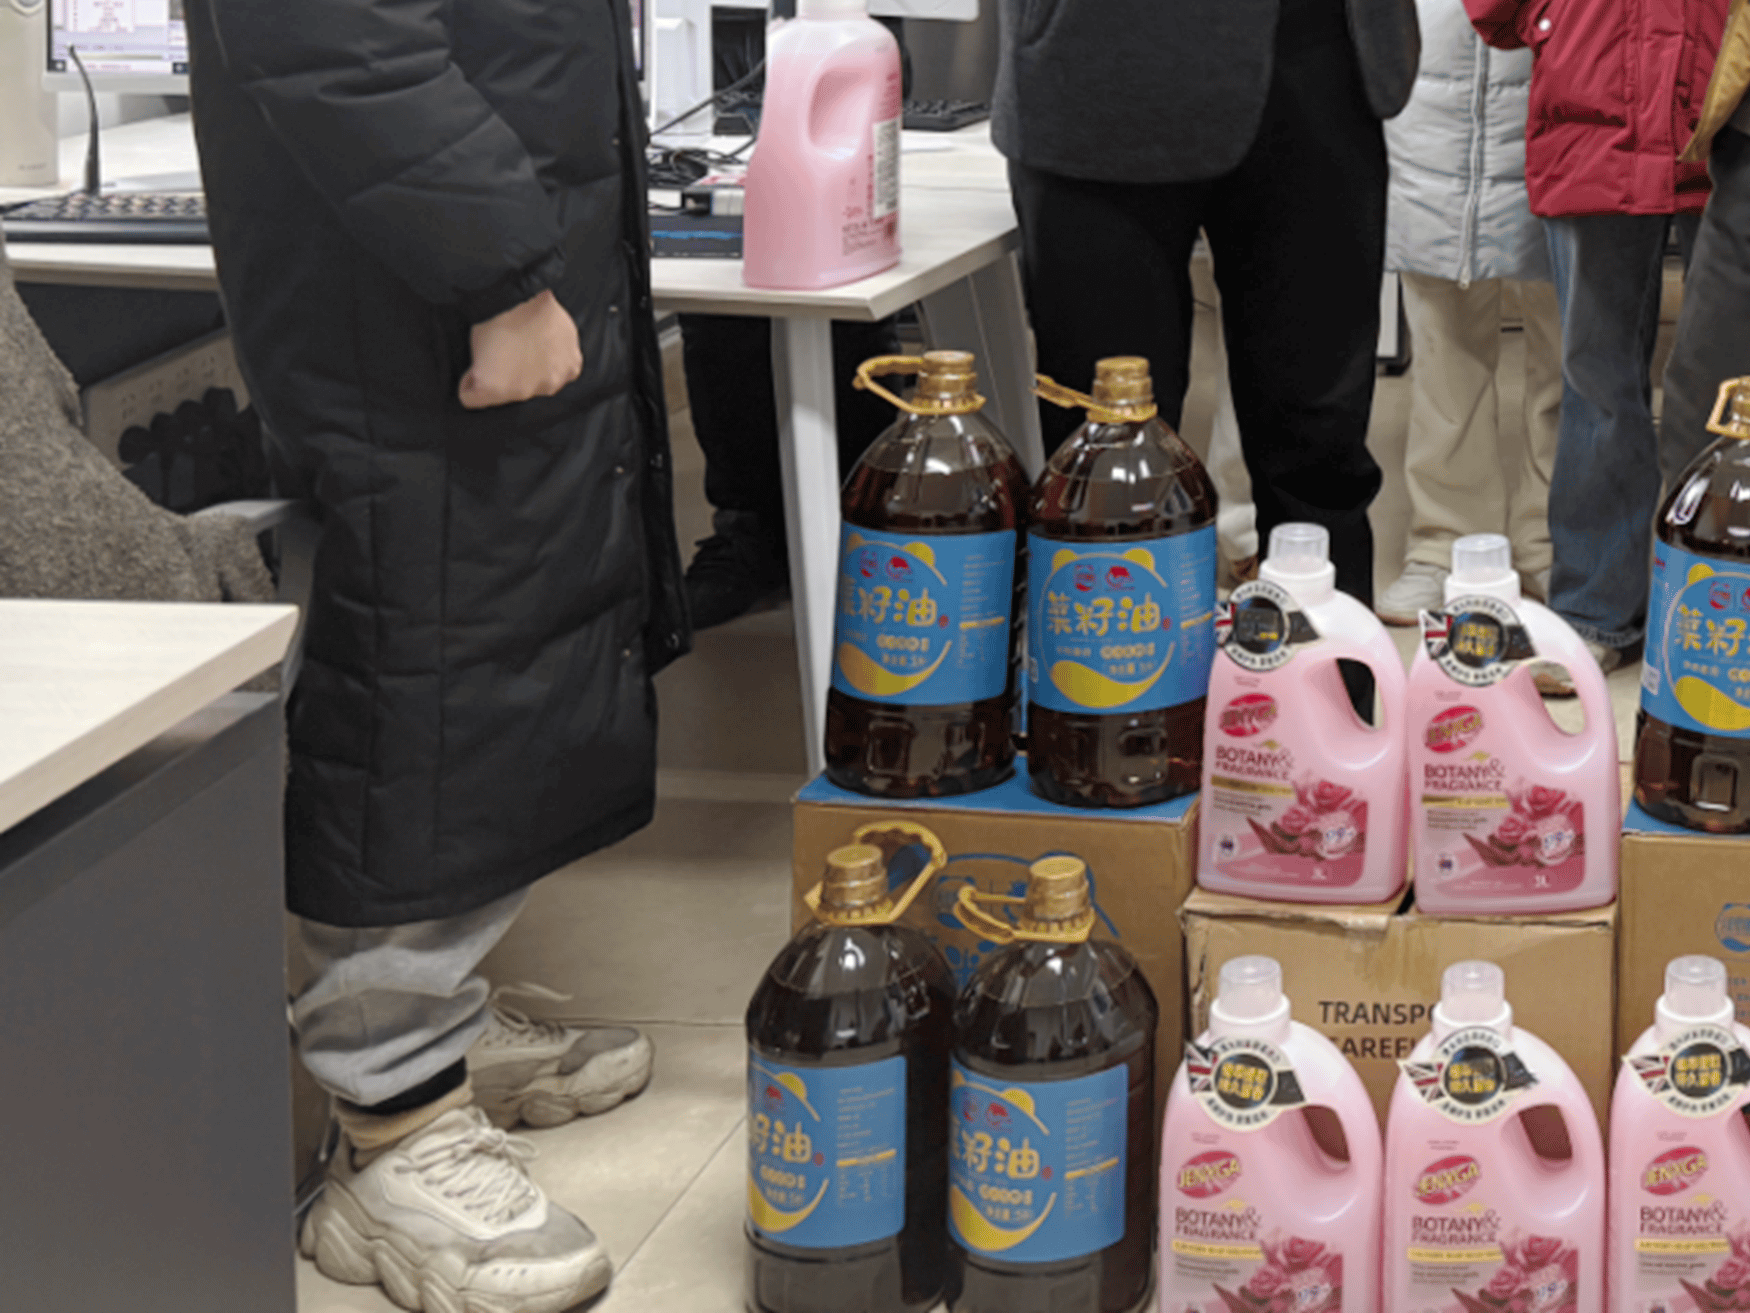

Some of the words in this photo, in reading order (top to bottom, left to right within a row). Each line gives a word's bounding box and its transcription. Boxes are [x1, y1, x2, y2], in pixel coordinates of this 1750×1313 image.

[1047, 591, 1160, 637] 菜籽油
[1329, 1036, 1417, 1059] AREF
